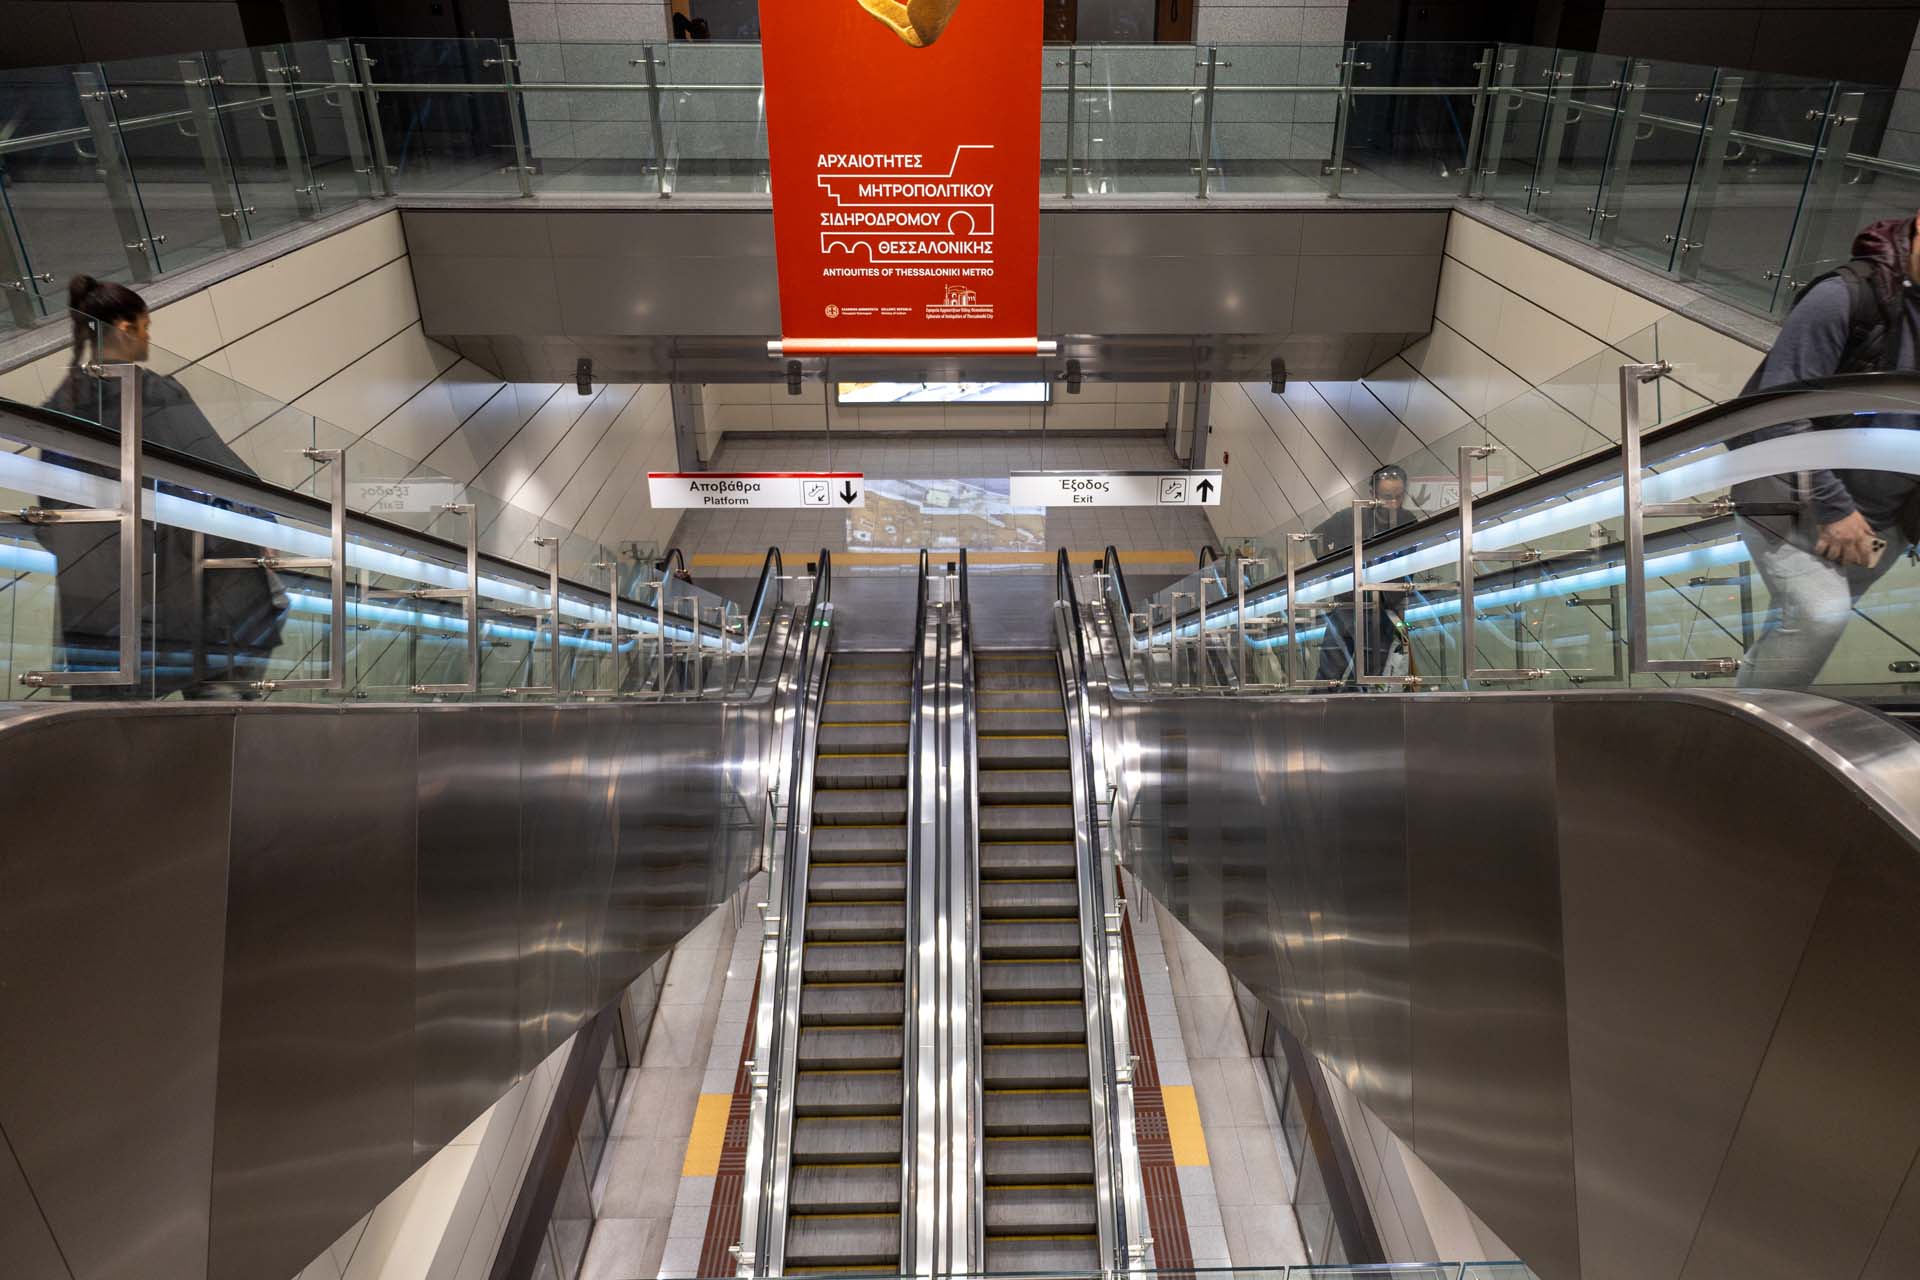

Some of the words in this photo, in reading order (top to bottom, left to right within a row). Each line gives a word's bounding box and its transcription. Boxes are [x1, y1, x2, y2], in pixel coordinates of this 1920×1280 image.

[817, 154, 923, 168] ΑΡΧΑΙΟΤΗΤΕΣ
[858, 183, 994, 198] ΜΗΤΡΟΠΟΛΙΤΙΚΟΥ
[820, 212, 941, 226] ΣΙΔΗΡΟΔΡΟΜΟΥ
[878, 241, 993, 254] ΘΕΣΣΑΛΟΝΙΚΗΣ
[823, 268, 880, 277] ANTIQUITIES
[881, 268, 894, 277] OF
[895, 268, 960, 277] THESSALONIKI
[962, 268, 994, 277] METRO
[689, 480, 761, 494] Αποβάθρα
[1059, 479, 1110, 492] Έξοδος
[703, 496, 749, 505] Platform
[1073, 495, 1093, 503] Exit
